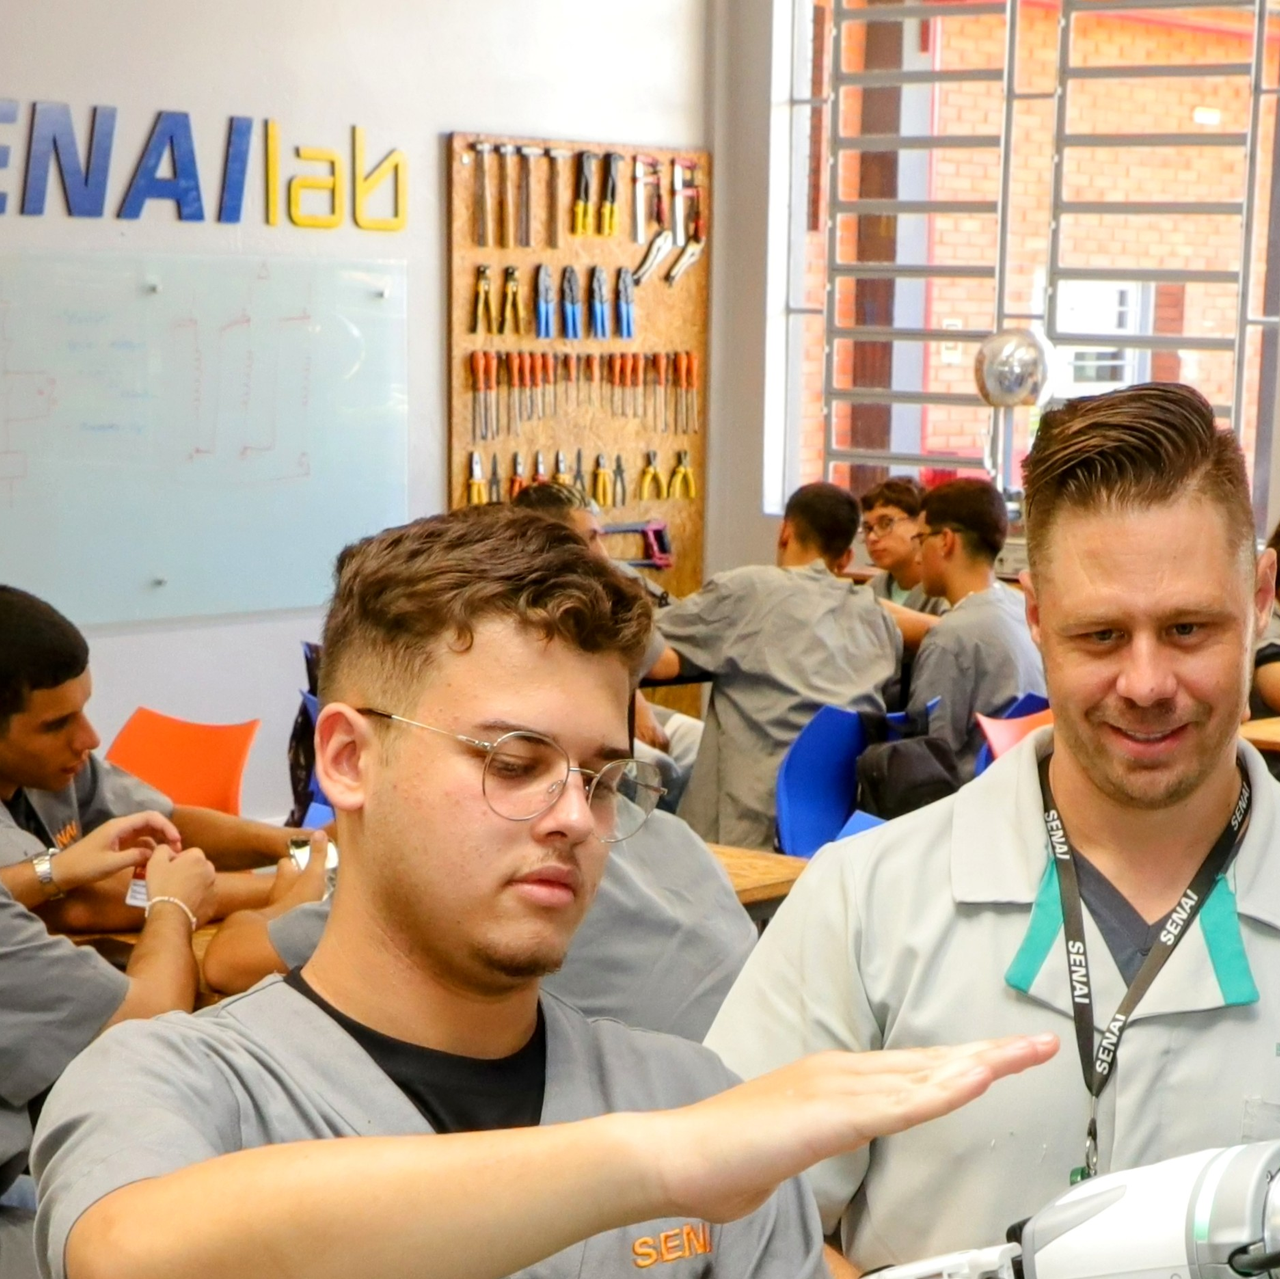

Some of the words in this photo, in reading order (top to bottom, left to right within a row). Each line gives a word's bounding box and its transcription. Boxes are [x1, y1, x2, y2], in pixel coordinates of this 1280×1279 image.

[1044, 809, 1071, 860] SENAI
[1231, 780, 1251, 831] SENAI
[1160, 888, 1200, 946] SENAI
[1068, 940, 1090, 1004] SENAI
[1095, 1013, 1127, 1076] SENAI
